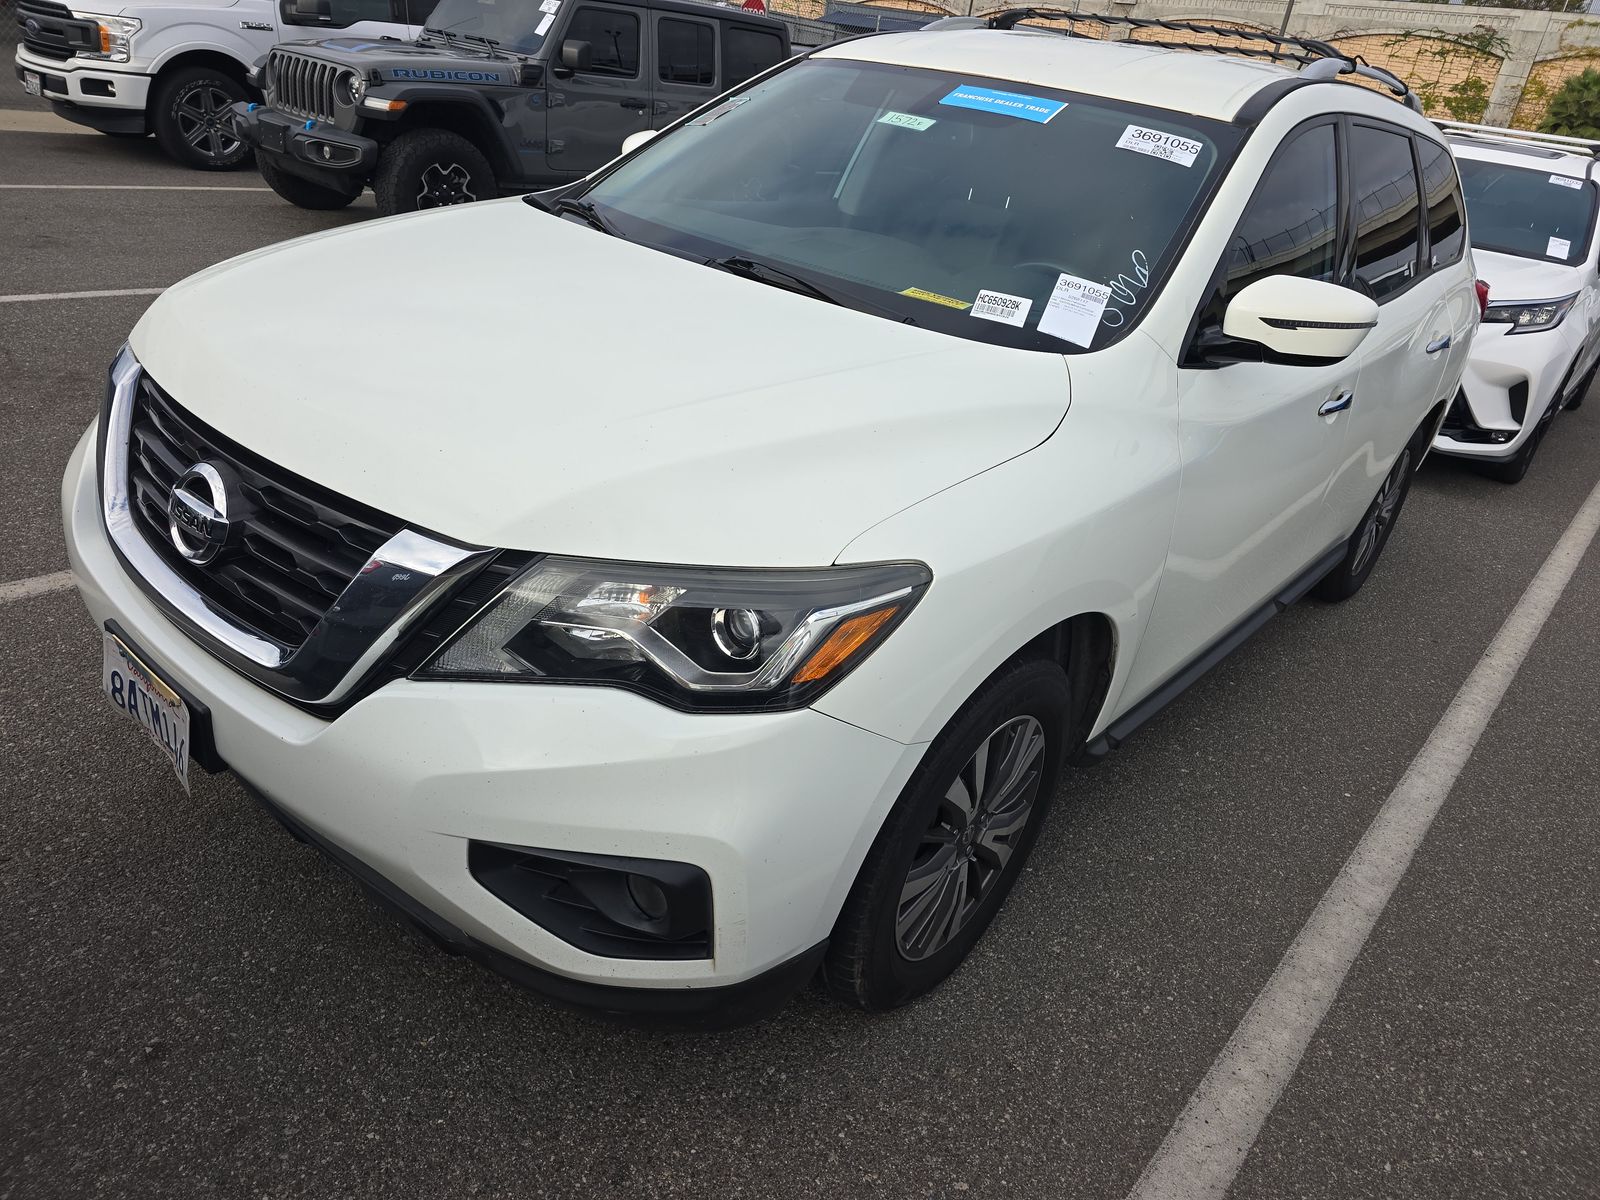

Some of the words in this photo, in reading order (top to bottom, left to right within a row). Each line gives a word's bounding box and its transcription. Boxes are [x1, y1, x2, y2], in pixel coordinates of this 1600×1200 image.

[391, 68, 500, 82] RUBICON
[953, 92, 993, 103] FRANCHISE
[994, 99, 1024, 109] DEALER
[1024, 103, 1051, 114] TRADE
[1131, 129, 1200, 155] 3691055
[1059, 278, 1110, 300] 3691055
[977, 293, 1023, 310] HC650928K
